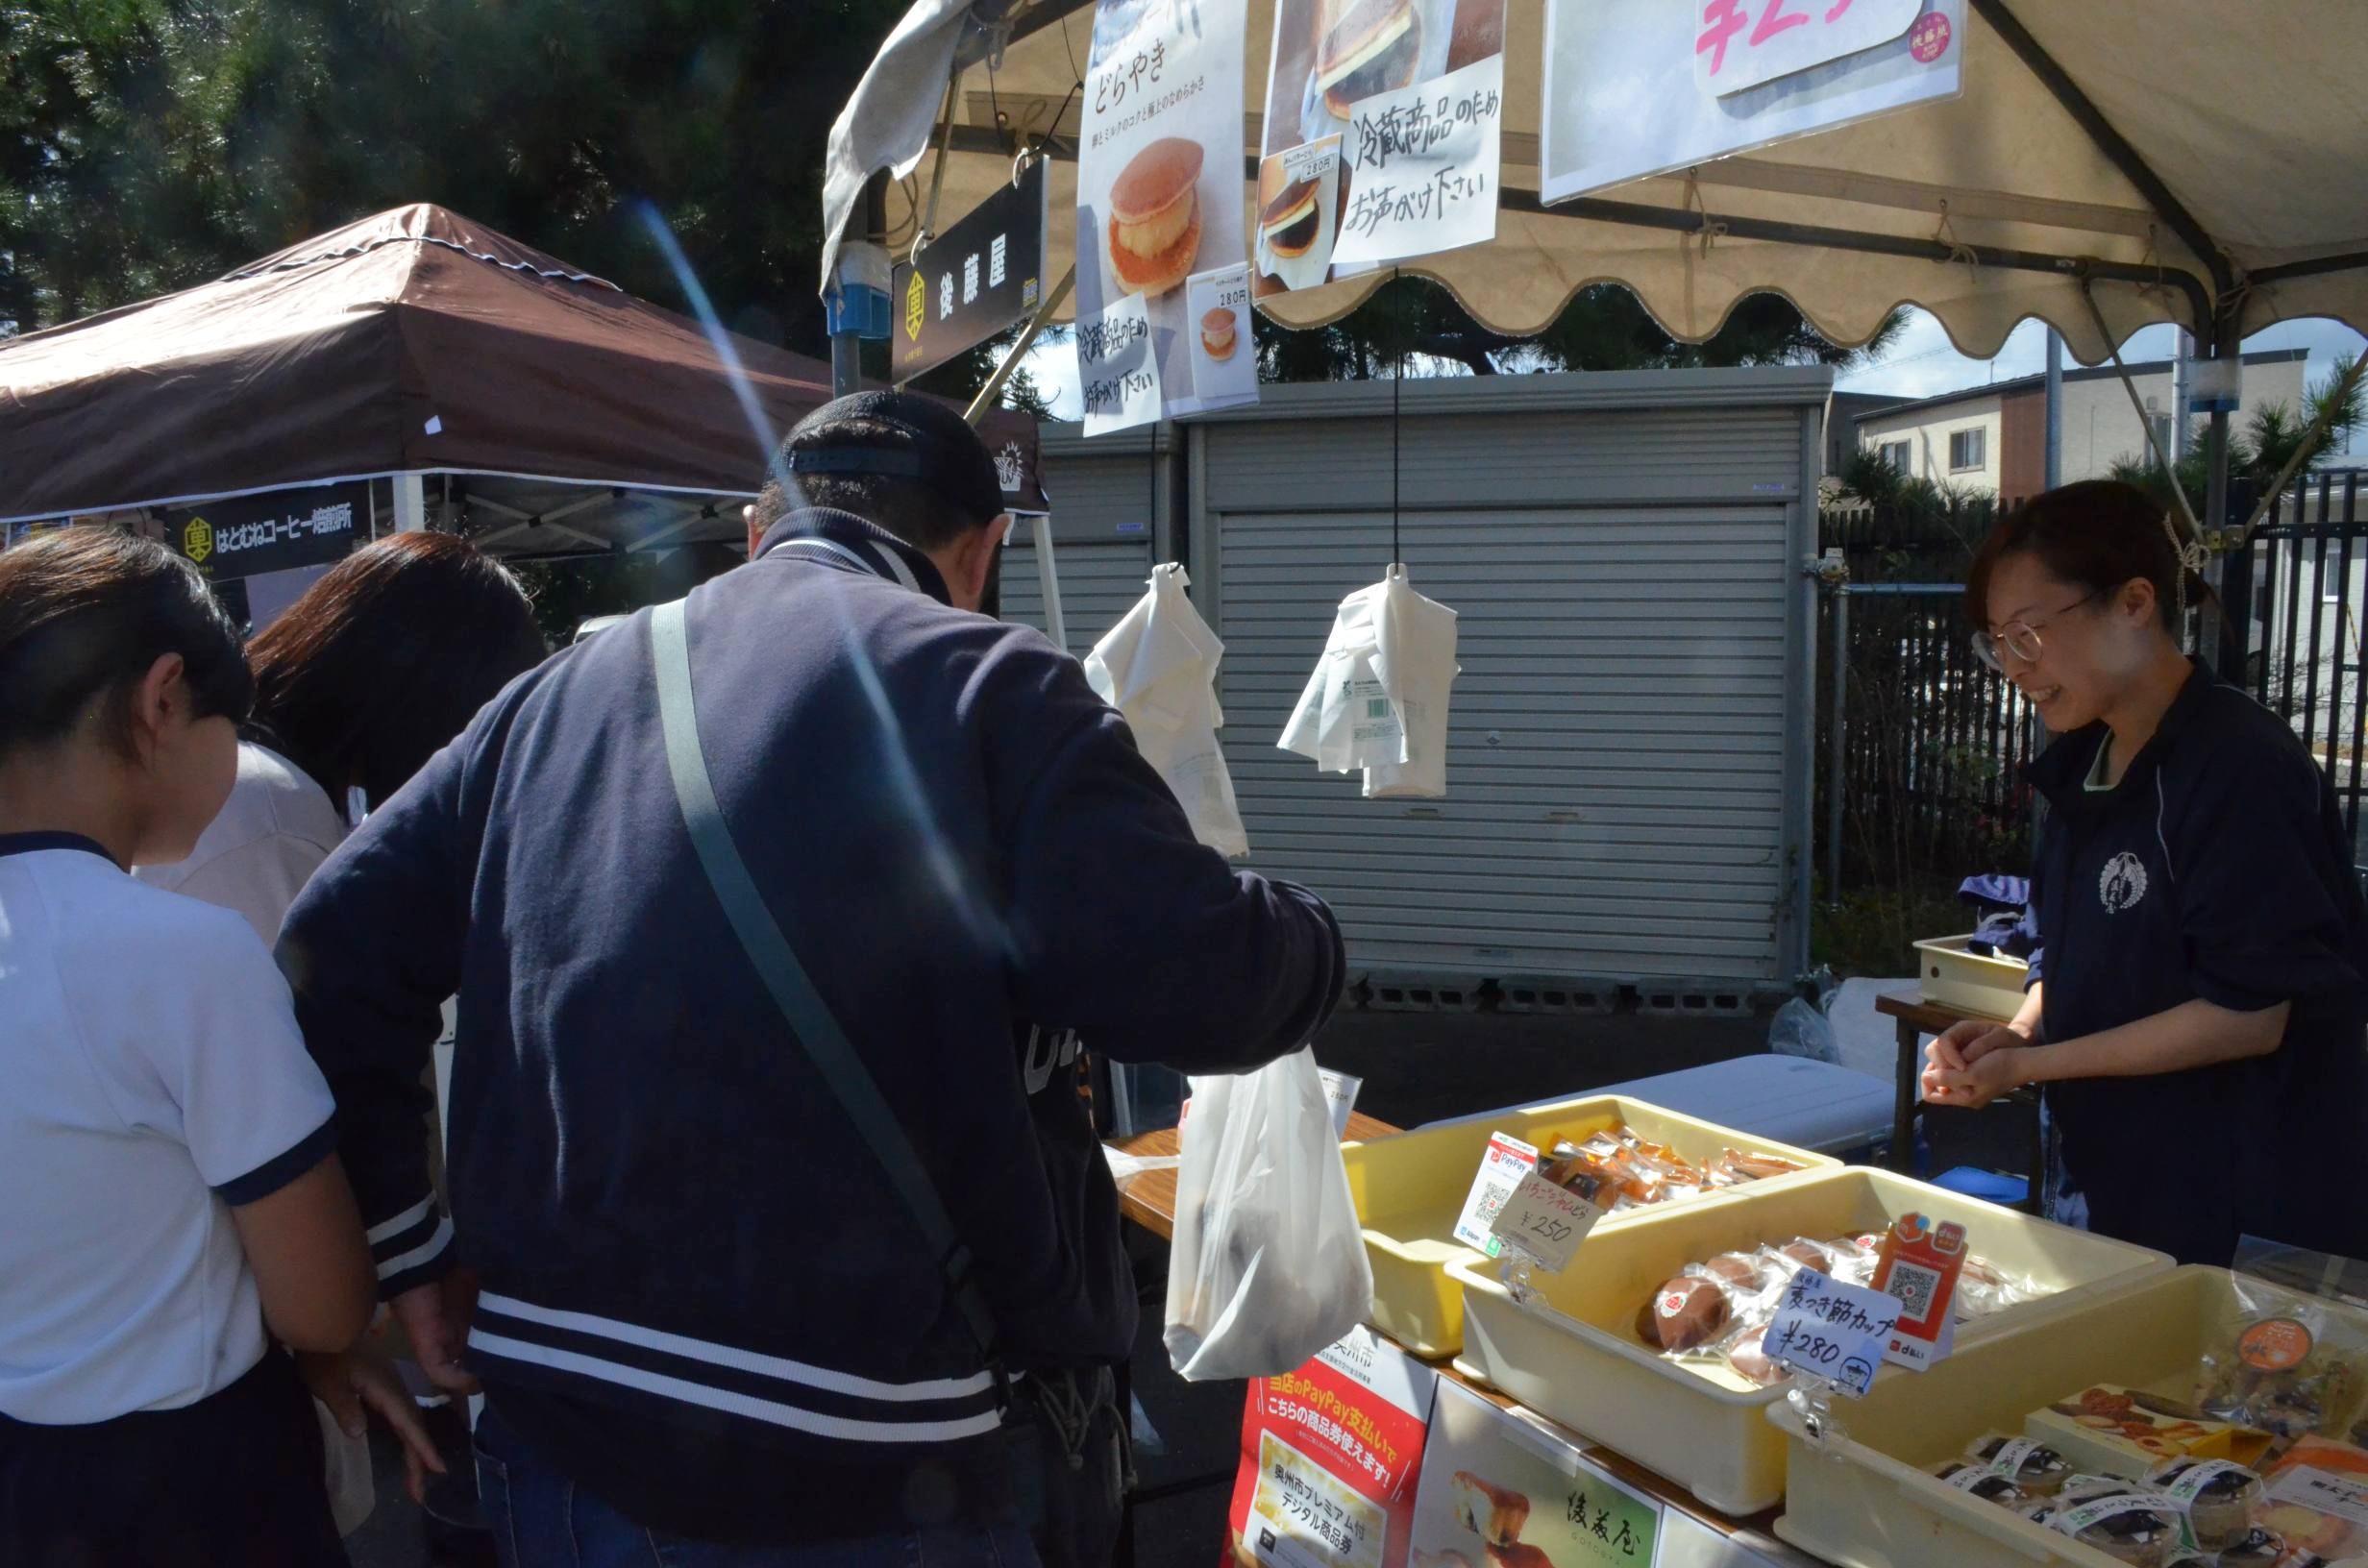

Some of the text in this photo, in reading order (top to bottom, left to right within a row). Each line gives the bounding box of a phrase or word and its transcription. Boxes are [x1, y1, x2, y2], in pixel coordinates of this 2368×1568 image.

[1096, 37, 1165, 114] どらやき
[1353, 89, 1499, 172] 冷蔵商品のため
[1306, 158, 1330, 175] 280円
[1344, 165, 1484, 238] お声がけ下さい
[939, 233, 1006, 321] 後藤屋
[1220, 289, 1246, 306] 280円
[1076, 316, 1147, 366] 冷蔵商品のため
[1084, 369, 1153, 419] お声がけ下さい
[215, 502, 353, 554] はとむねコーヒー焙煎所
[1501, 1152, 1526, 1173] PayPay
[1520, 1210, 1572, 1241] ¥250
[1780, 1319, 1840, 1363] ¥280
[1274, 1463, 1367, 1541] 奥州市プレミアム付
[1282, 1492, 1353, 1556] デジタル商品券
